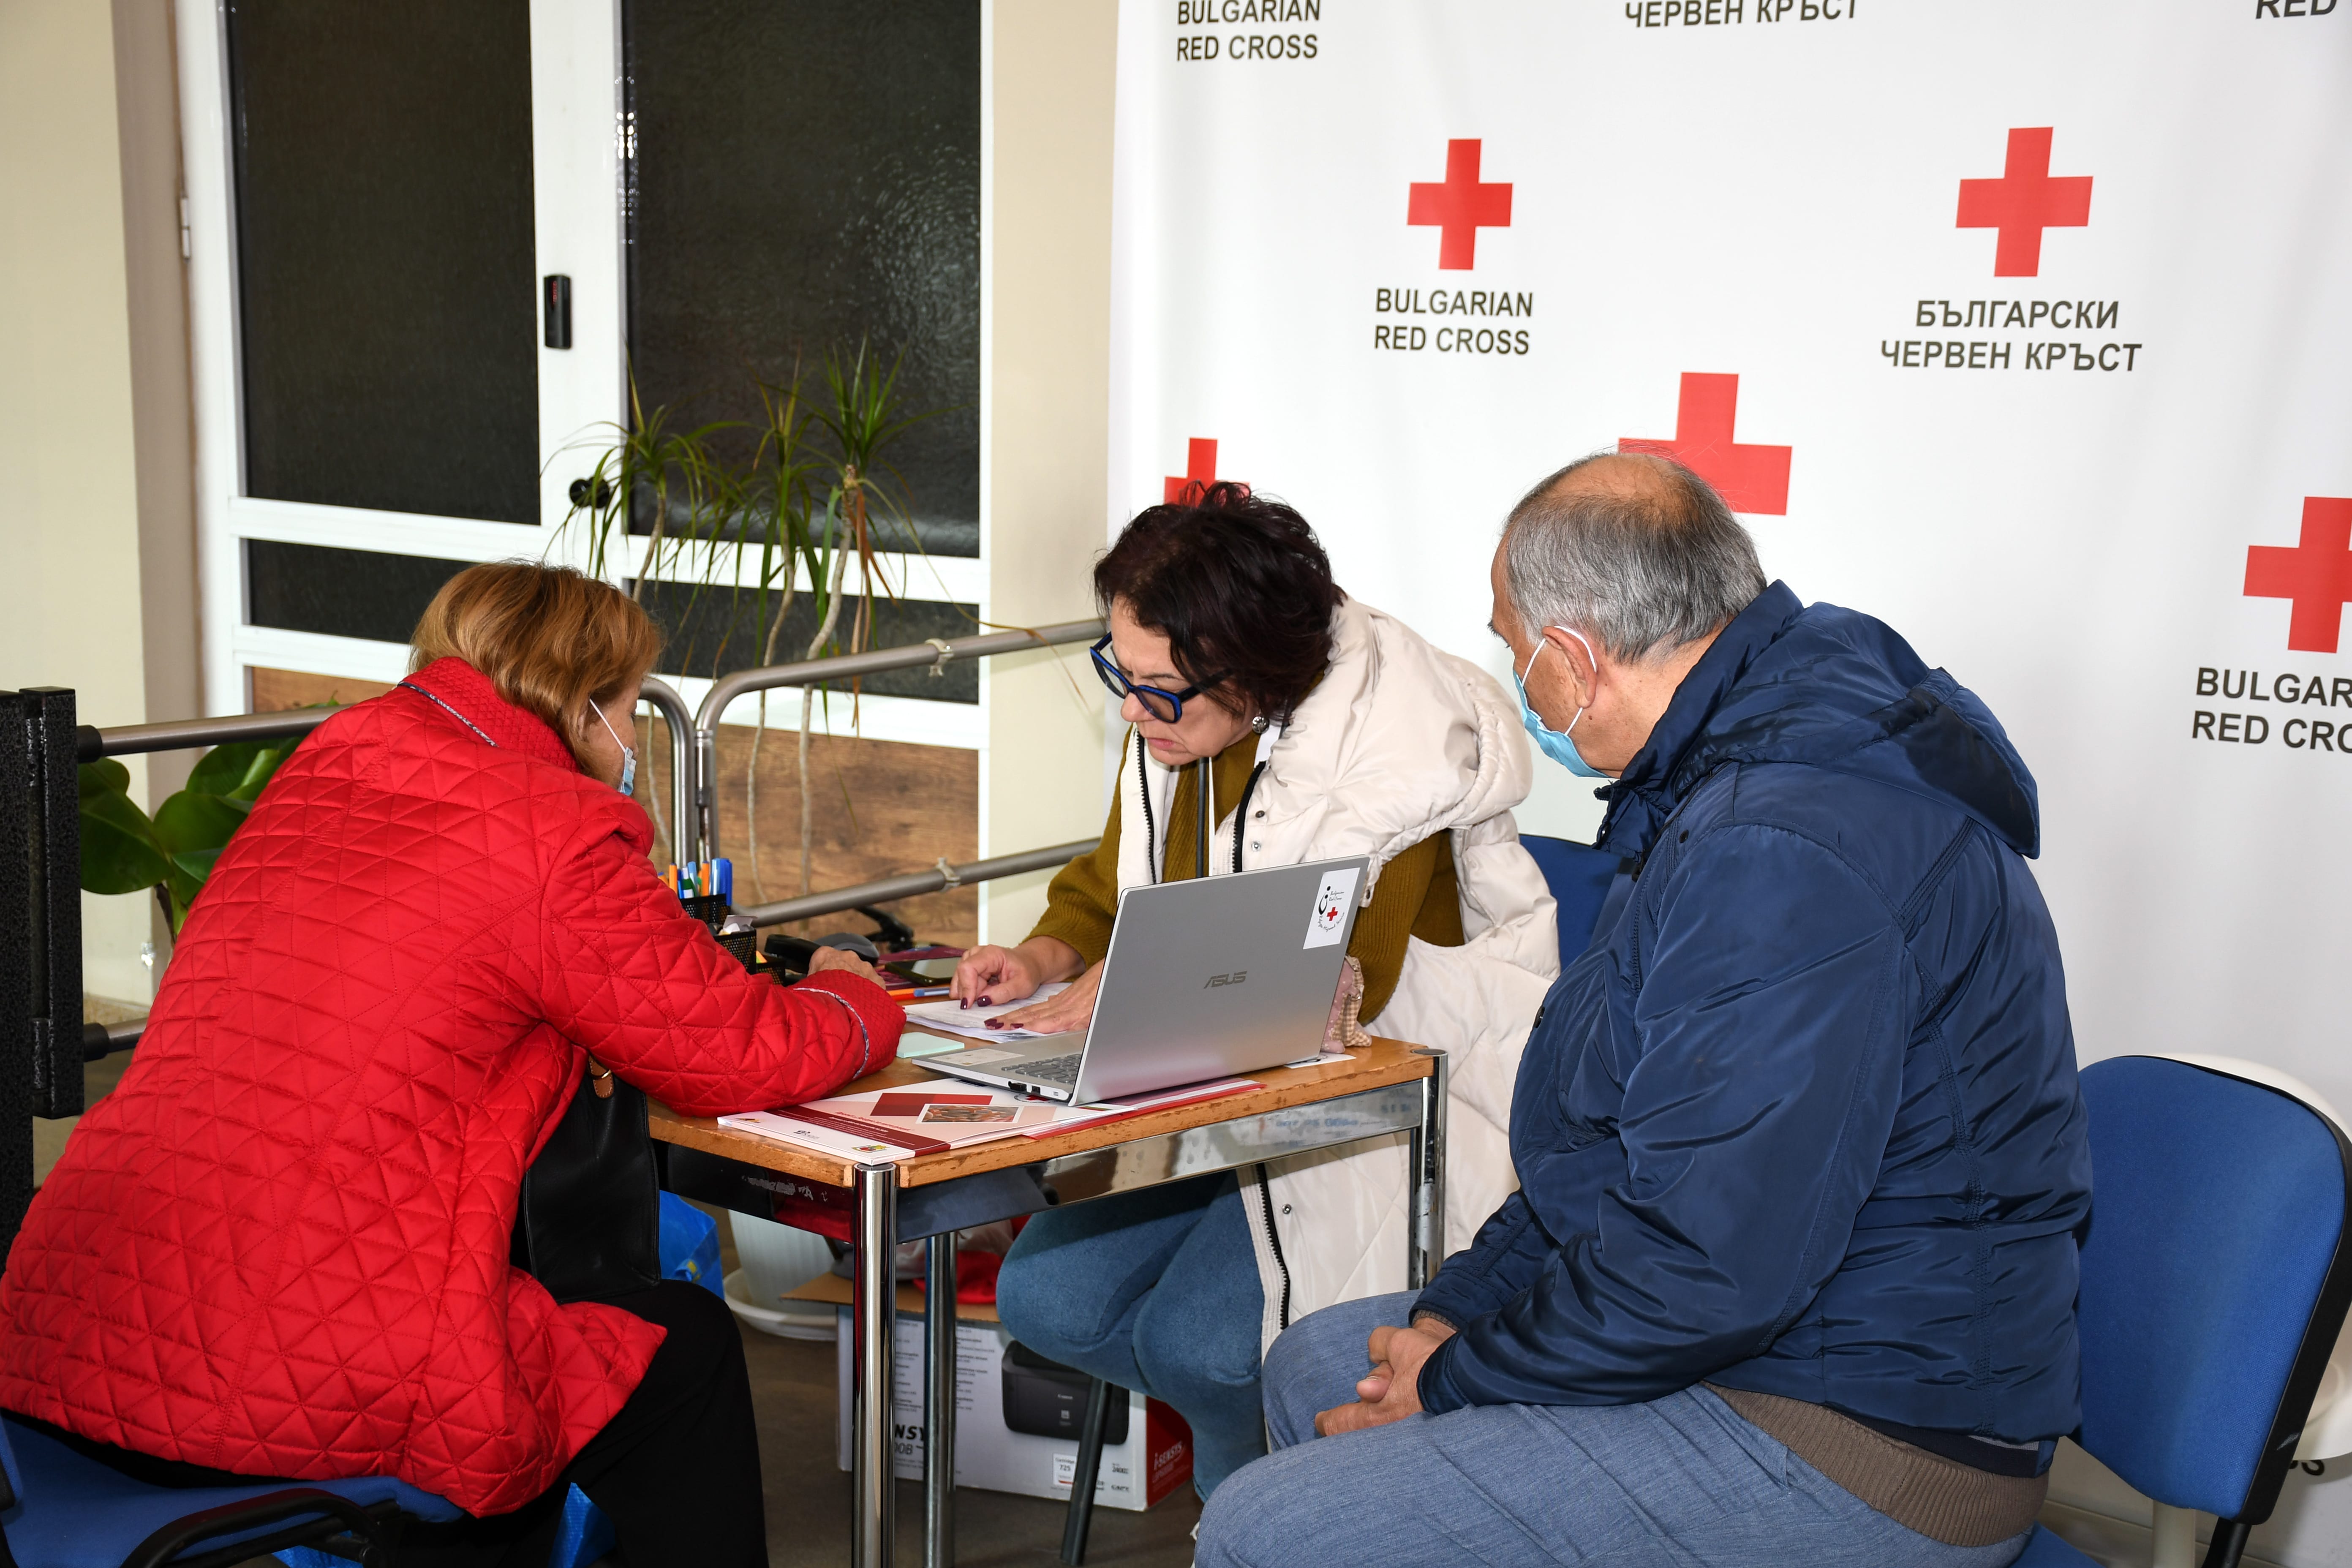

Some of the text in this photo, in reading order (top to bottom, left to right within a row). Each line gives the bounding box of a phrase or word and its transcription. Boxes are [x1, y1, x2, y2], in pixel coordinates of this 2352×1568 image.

[1178, 0, 1320, 25] BULGARIAN
[1626, 0, 1743, 27] ЧЕРВЕН
[1177, 34, 1317, 61] RED CROSS
[1377, 289, 1533, 317] BULGARIAN
[1916, 300, 2118, 329] БЪЛГАРСКИ
[1375, 325, 1529, 355] RED CROSS
[1882, 340, 2142, 371] ЧЕРВЕН КРЪСТ
[2196, 667, 2352, 708] BULGAR
[2192, 710, 2352, 754] RED CRO
[1203, 971, 1247, 989] ASUS
